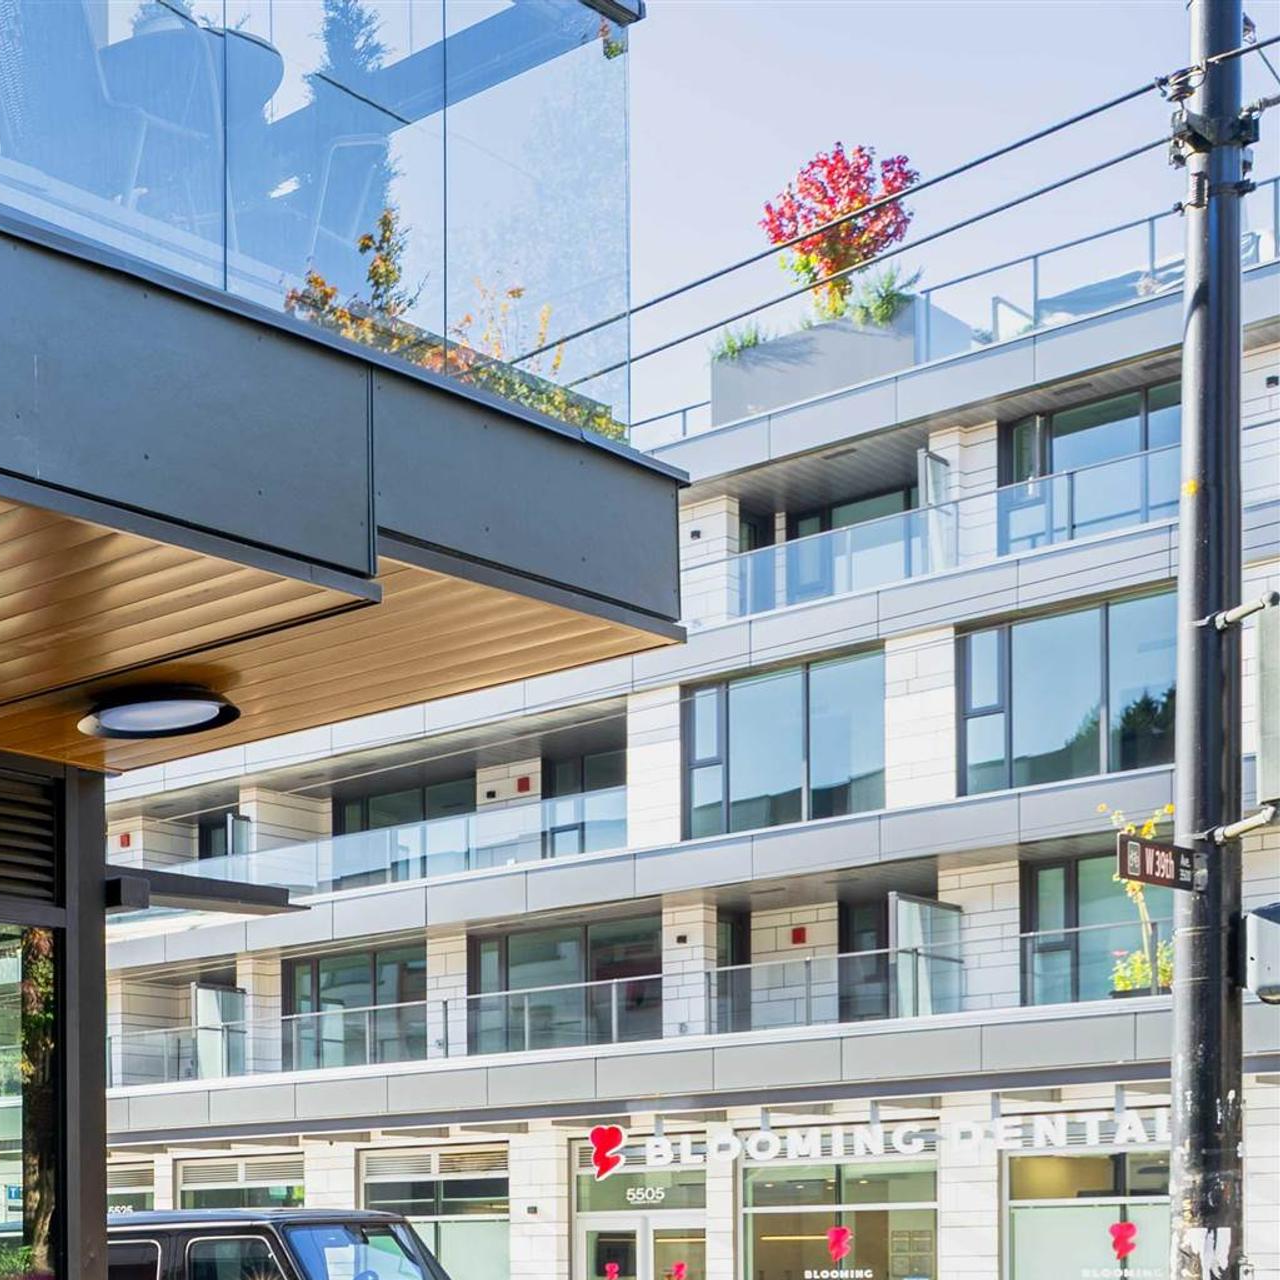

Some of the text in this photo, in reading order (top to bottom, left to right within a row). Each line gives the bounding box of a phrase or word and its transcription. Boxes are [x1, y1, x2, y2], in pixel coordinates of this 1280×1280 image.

[1145, 847, 1175, 880] W 39th
[645, 1123, 925, 1166] BLOOMING
[626, 1187, 665, 1201] 5505
[804, 1269, 873, 1280] BLOOMING
